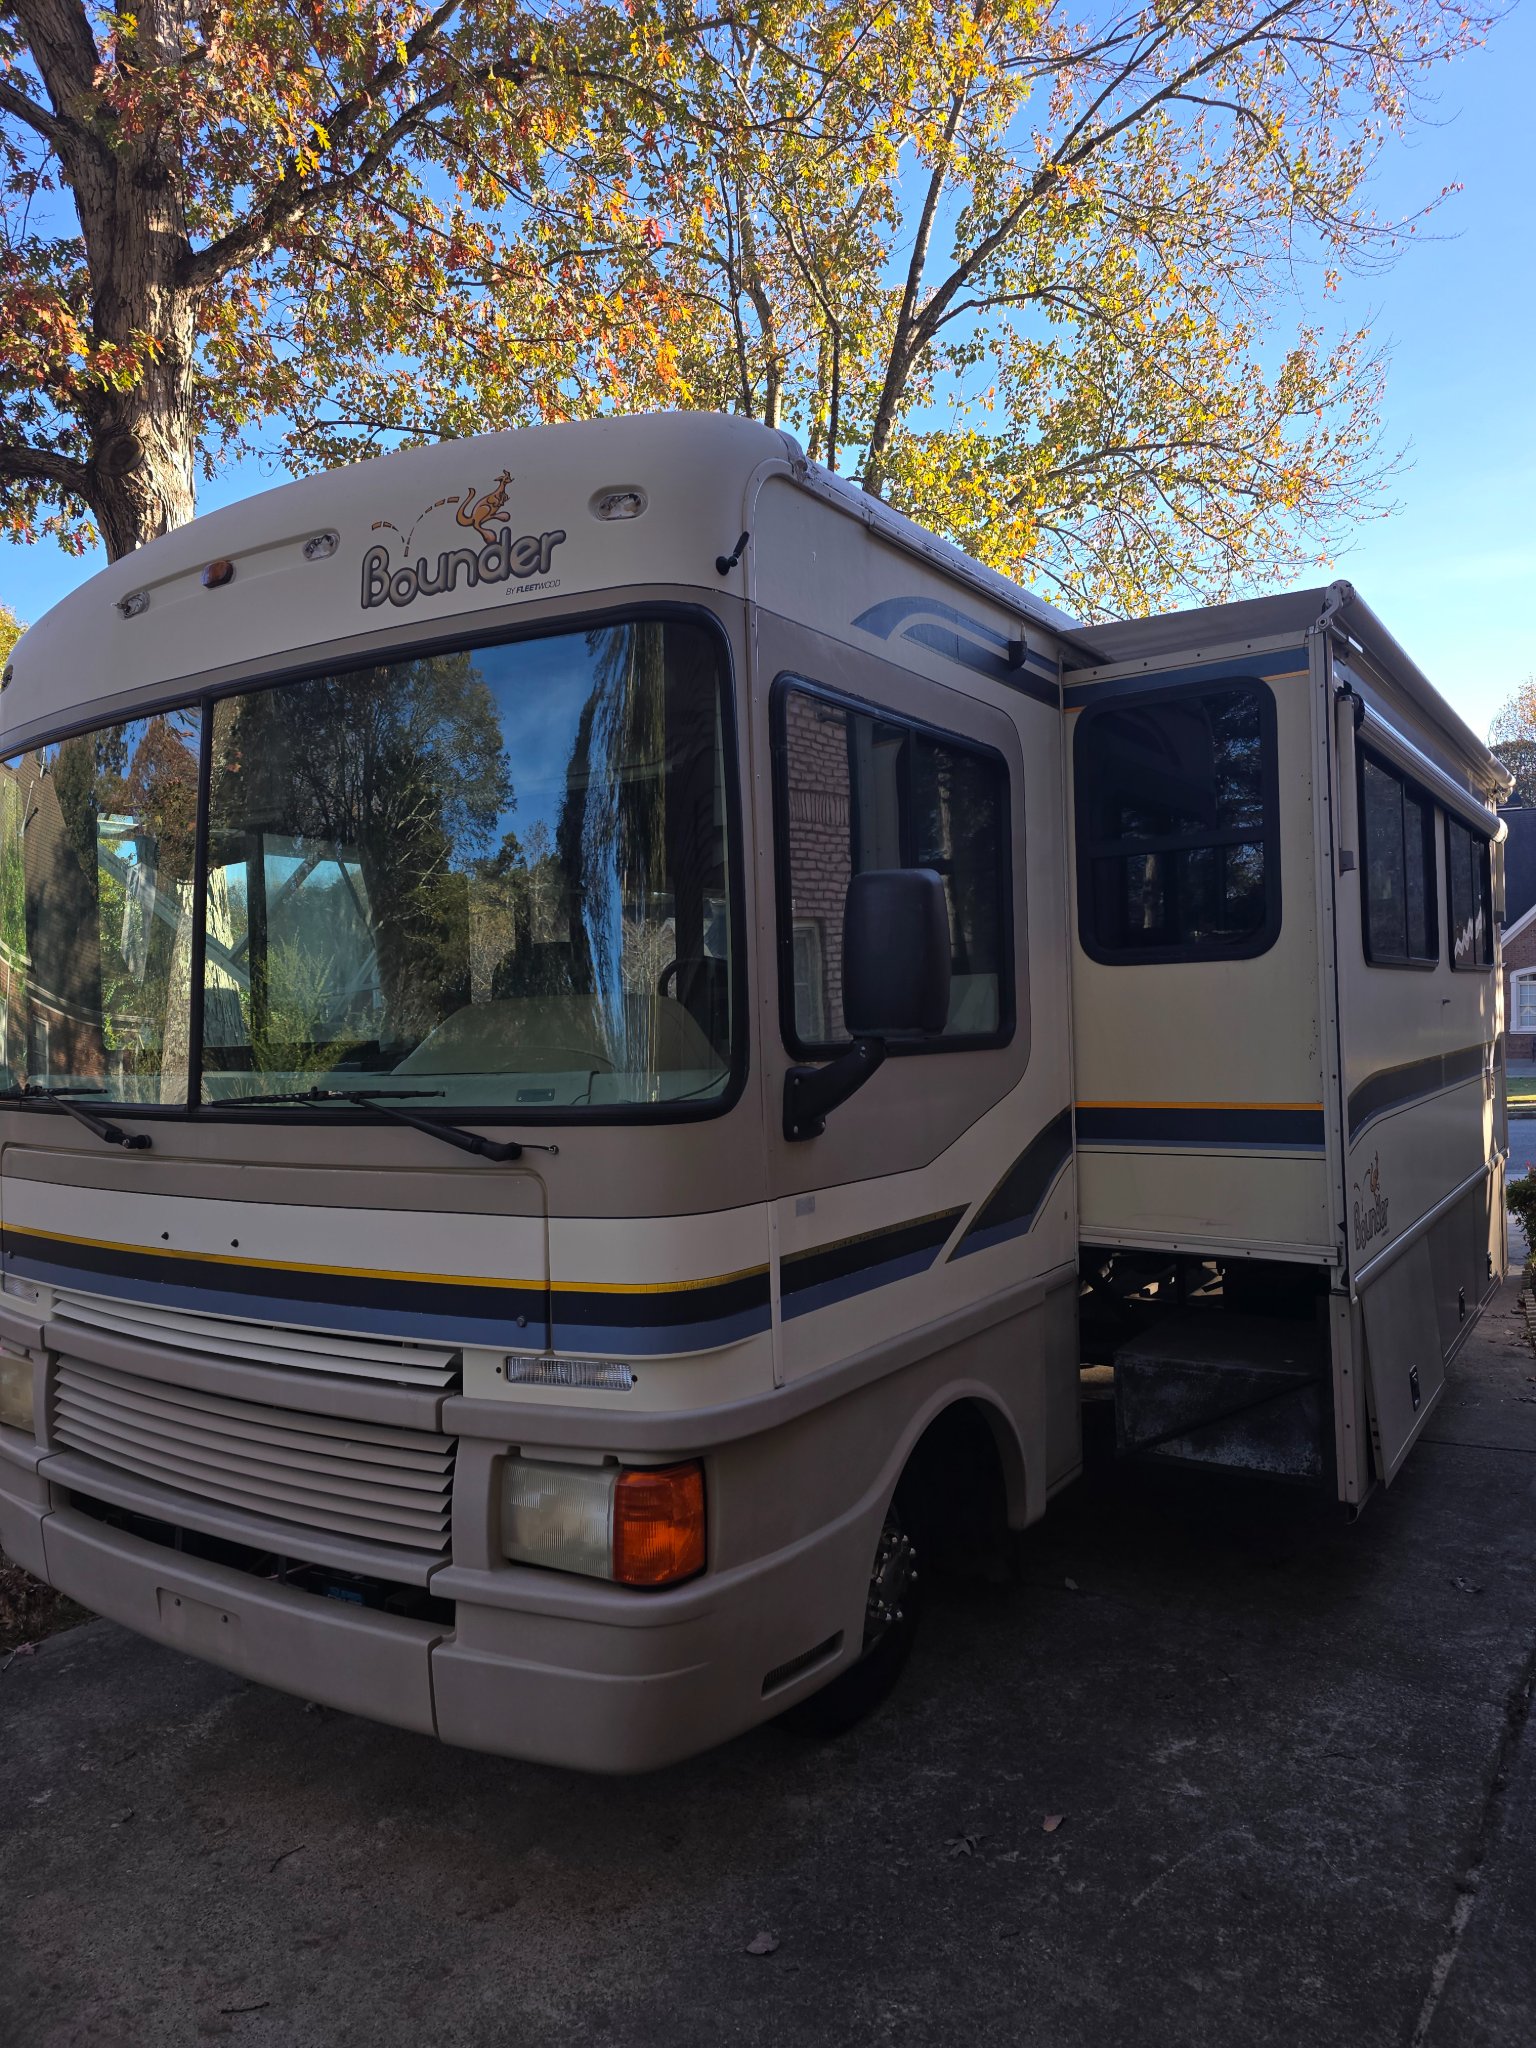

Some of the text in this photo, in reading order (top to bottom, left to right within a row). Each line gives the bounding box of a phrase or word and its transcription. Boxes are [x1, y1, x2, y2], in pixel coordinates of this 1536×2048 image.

[361, 527, 566, 609] Bounder
[506, 579, 561, 596] BY FLEETWOOD
[1354, 1194, 1389, 1251] Bounder
